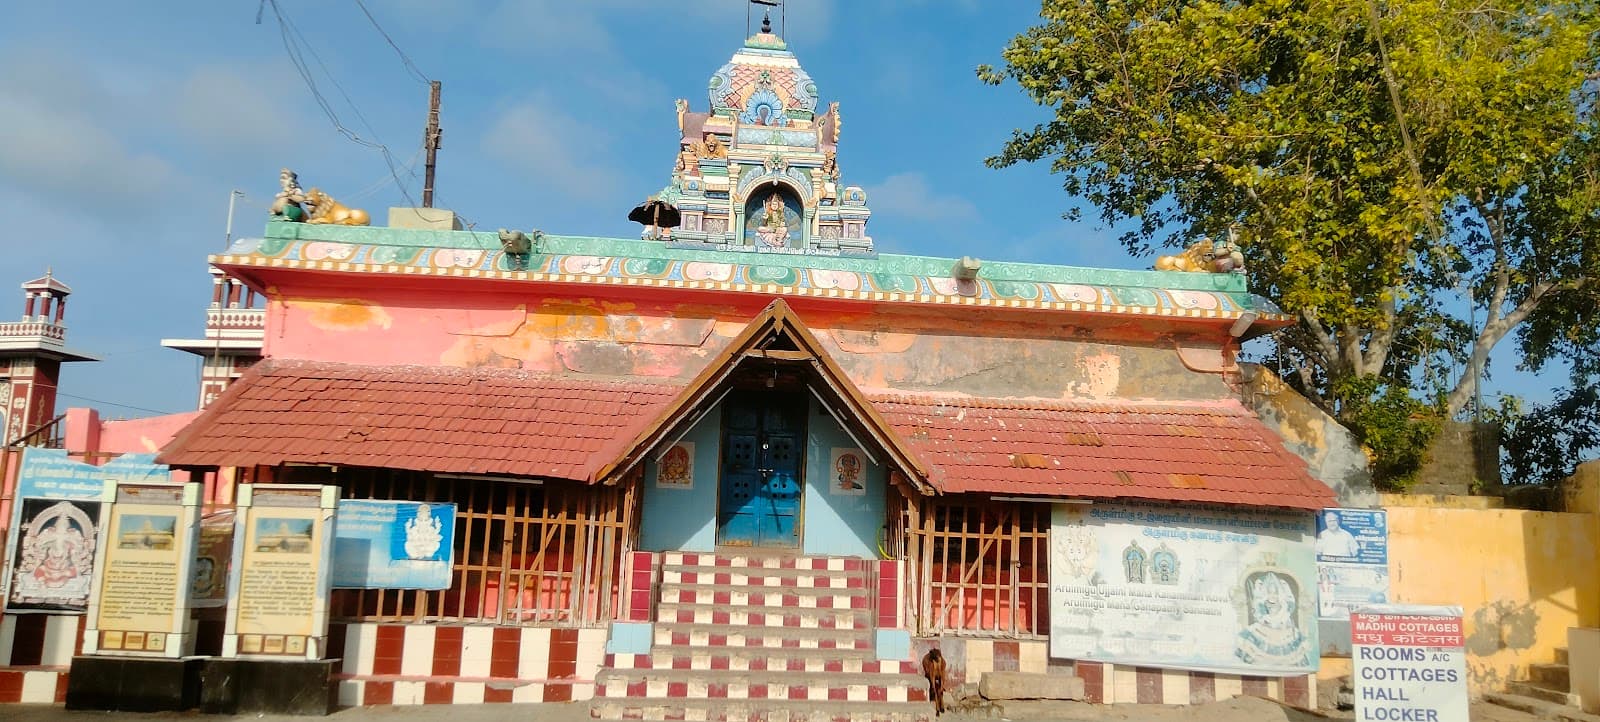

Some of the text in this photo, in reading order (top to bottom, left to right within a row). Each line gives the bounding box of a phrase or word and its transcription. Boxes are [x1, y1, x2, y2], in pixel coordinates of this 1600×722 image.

[1356, 622, 1459, 633] MADHU COTTAGES
[1354, 633, 1385, 645] मधु
[1360, 647, 1426, 661] ROOMS
[1431, 653, 1450, 662] A/C
[1361, 666, 1458, 682] COTTAGES
[1362, 687, 1410, 701] HALL
[1364, 707, 1439, 722] LOCKER
